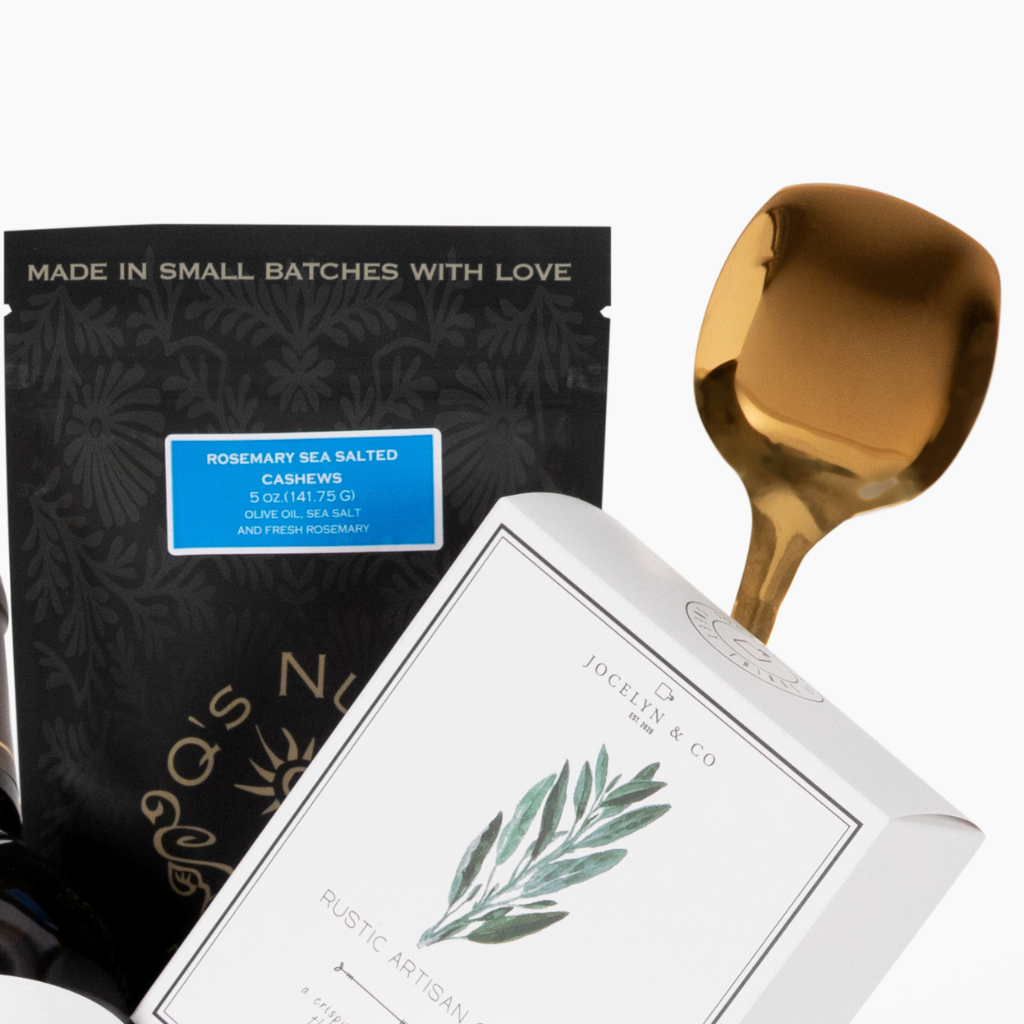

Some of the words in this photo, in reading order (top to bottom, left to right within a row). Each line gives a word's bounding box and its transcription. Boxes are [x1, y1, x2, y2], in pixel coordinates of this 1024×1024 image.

[28, 263, 107, 281] MADE
[119, 263, 147, 280] IN
[159, 262, 254, 281] SMALL
[265, 262, 399, 281] BATCHES
[411, 263, 483, 281] WITH
[496, 263, 571, 282] LOVE
[207, 451, 295, 465] ROSEMARY
[300, 450, 331, 464] SEA
[335, 449, 398, 462] SALTED
[262, 472, 343, 485] CASHEWS
[249, 491, 260, 504] 5
[339, 489, 355, 503] G)
[244, 509, 278, 520] OLIVE
[280, 508, 302, 521] OIL,
[306, 508, 329, 519] SEA
[331, 508, 361, 518] SALT
[237, 525, 261, 535] AND
[265, 525, 302, 535] FRESH
[306, 524, 370, 535] ROSEMARY
[279, 652, 357, 715] NU
[583, 655, 665, 724] JOCELYN
[670, 727, 683, 741] &
[691, 743, 715, 766] CO
[628, 712, 639, 724] EST.
[640, 722, 654, 735] 2020
[318, 888, 389, 953] RUSTIC
[389, 951, 469, 1024] ARTISAN
